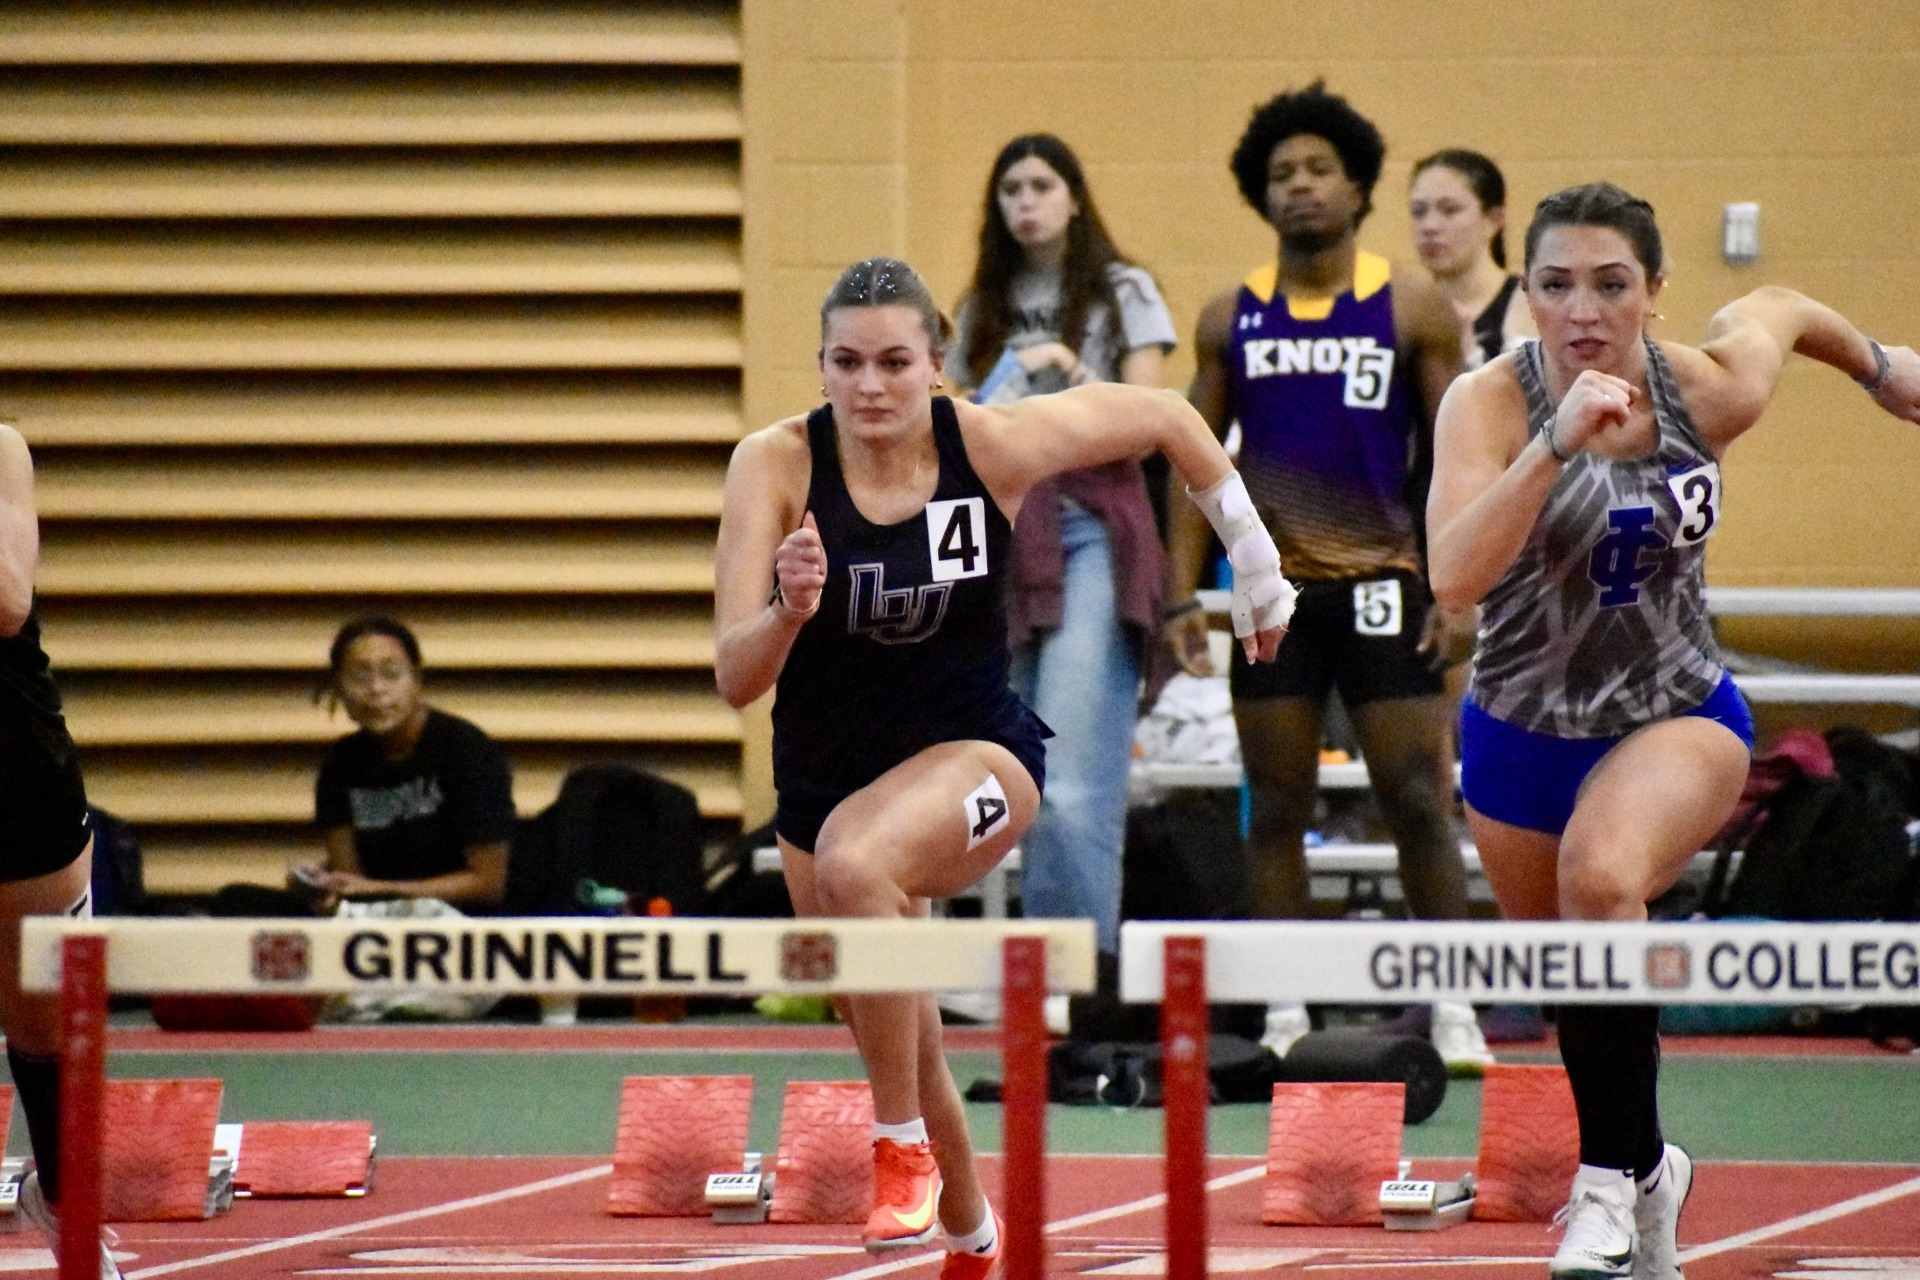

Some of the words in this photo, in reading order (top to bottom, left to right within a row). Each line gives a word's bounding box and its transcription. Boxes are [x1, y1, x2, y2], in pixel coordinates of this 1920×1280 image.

[1353, 352, 1383, 402] 5
[1683, 473, 1715, 542] 3
[937, 504, 979, 572] 4
[1363, 579, 1393, 630] 5
[972, 795, 1007, 839] 4
[343, 931, 747, 983] GRINNELL
[1370, 941, 1630, 990] GRINNELL
[712, 1176, 756, 1185] GILL
